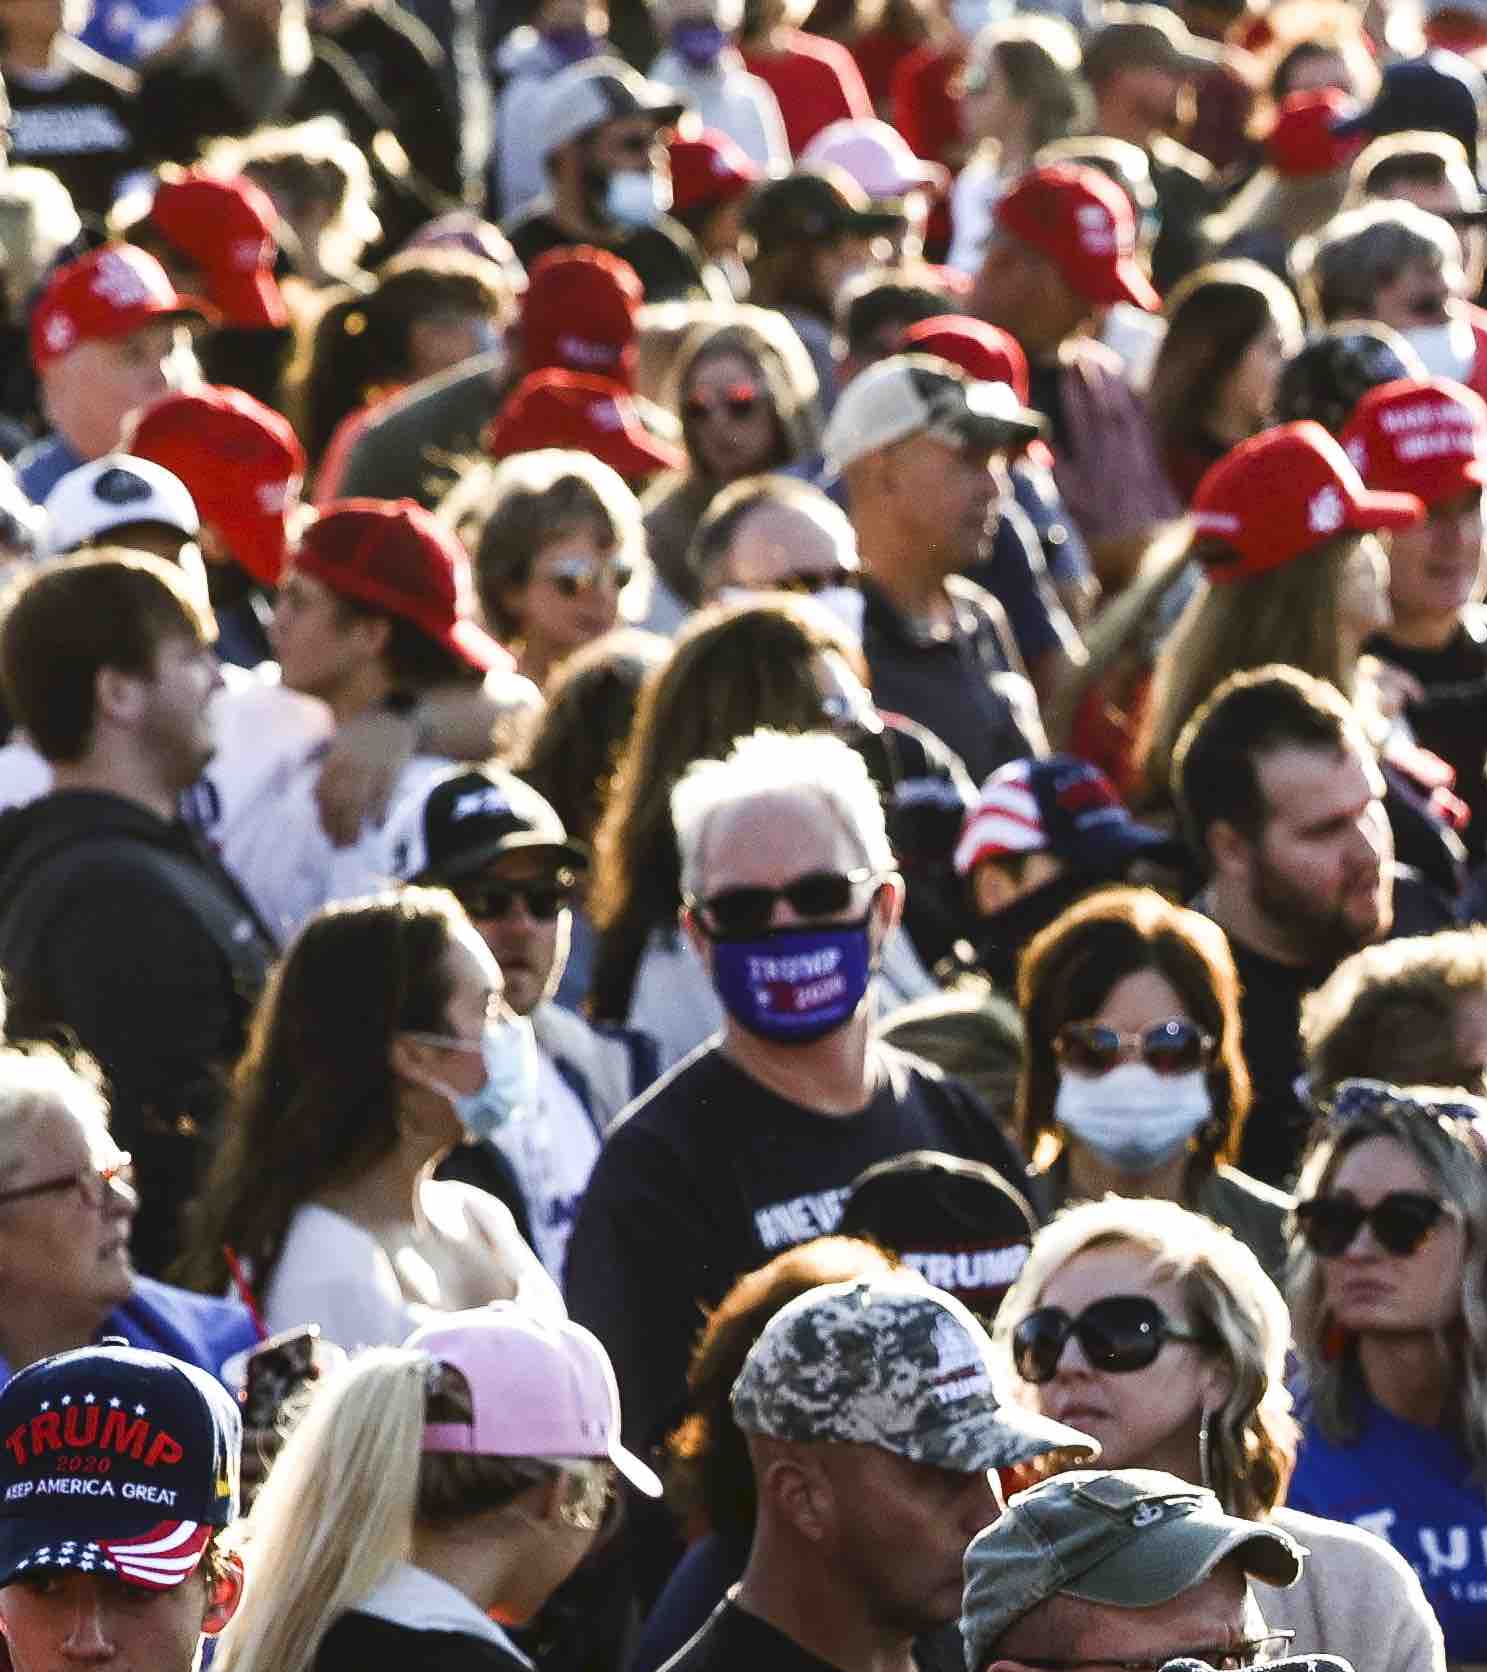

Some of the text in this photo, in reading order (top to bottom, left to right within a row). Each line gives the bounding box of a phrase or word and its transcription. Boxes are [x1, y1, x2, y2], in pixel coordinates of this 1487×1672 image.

[5, 1406, 184, 1468] TRUMP
[35, 1478, 116, 1497] AMERICA
[121, 1482, 178, 1507] GREAT
